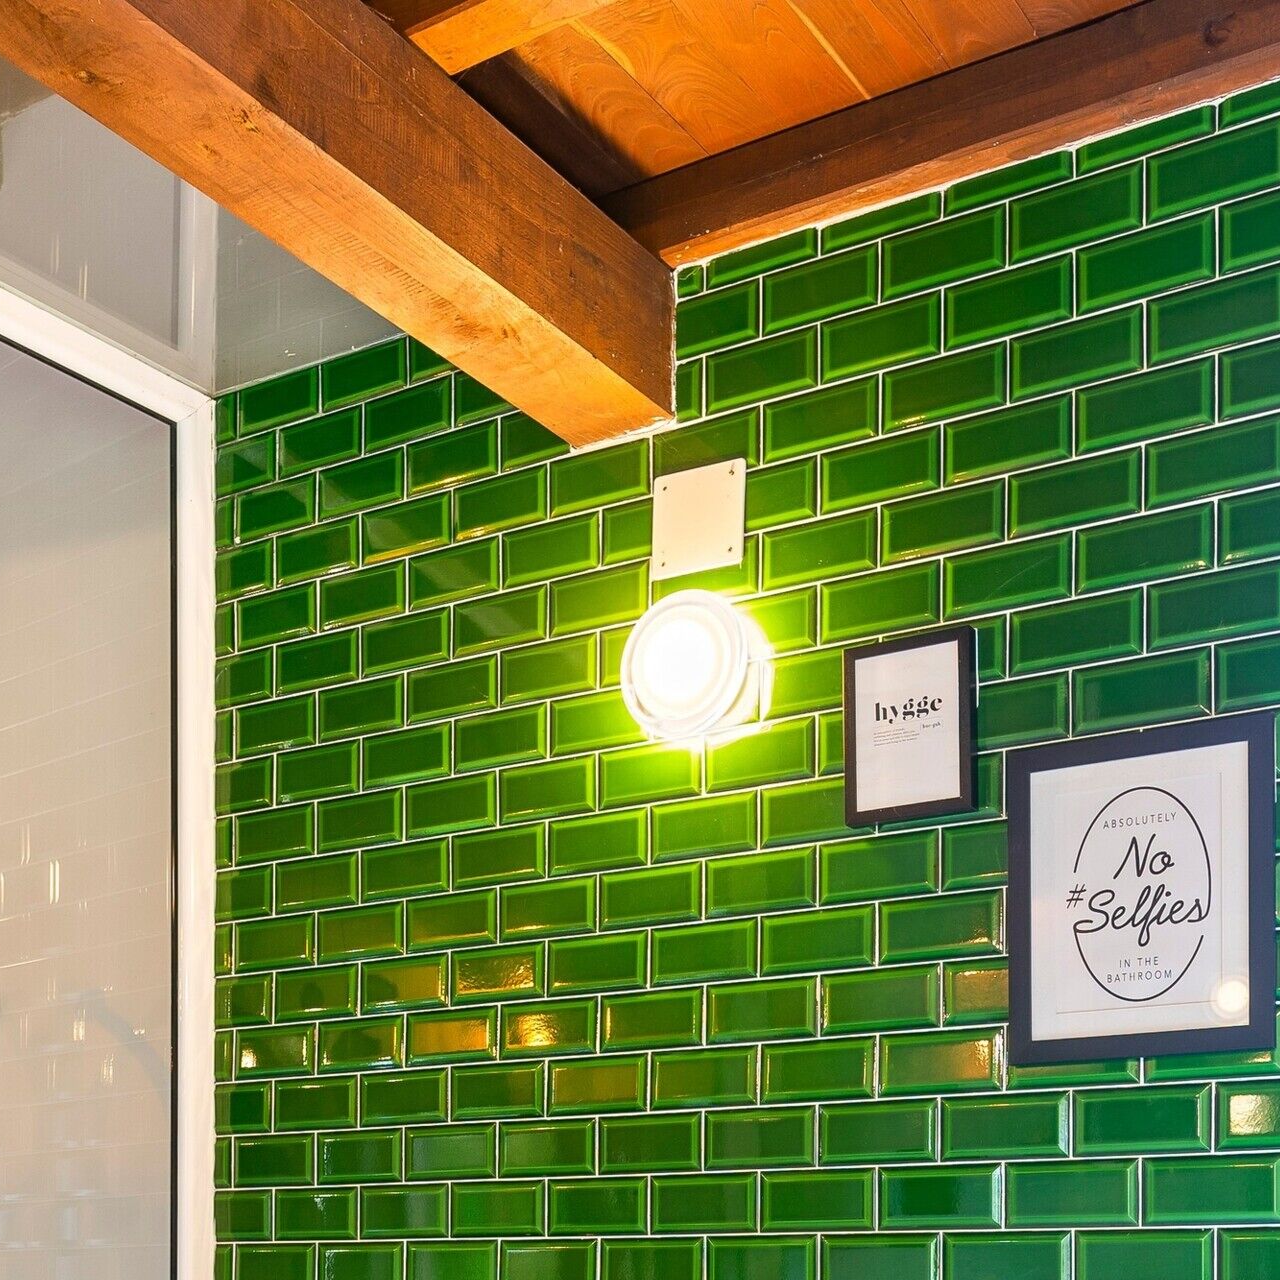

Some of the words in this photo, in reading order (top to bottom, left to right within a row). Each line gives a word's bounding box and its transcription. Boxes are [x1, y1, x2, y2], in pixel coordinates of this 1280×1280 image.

[875, 696, 942, 724] hygge
[1102, 811, 1177, 830] ABSOLUTELY
[1113, 833, 1175, 879] No
[1066, 884, 1204, 947] #Selfies
[1119, 959, 1131, 968] IN
[1137, 956, 1159, 966] THE
[1106, 969, 1172, 983] BATHROOM
